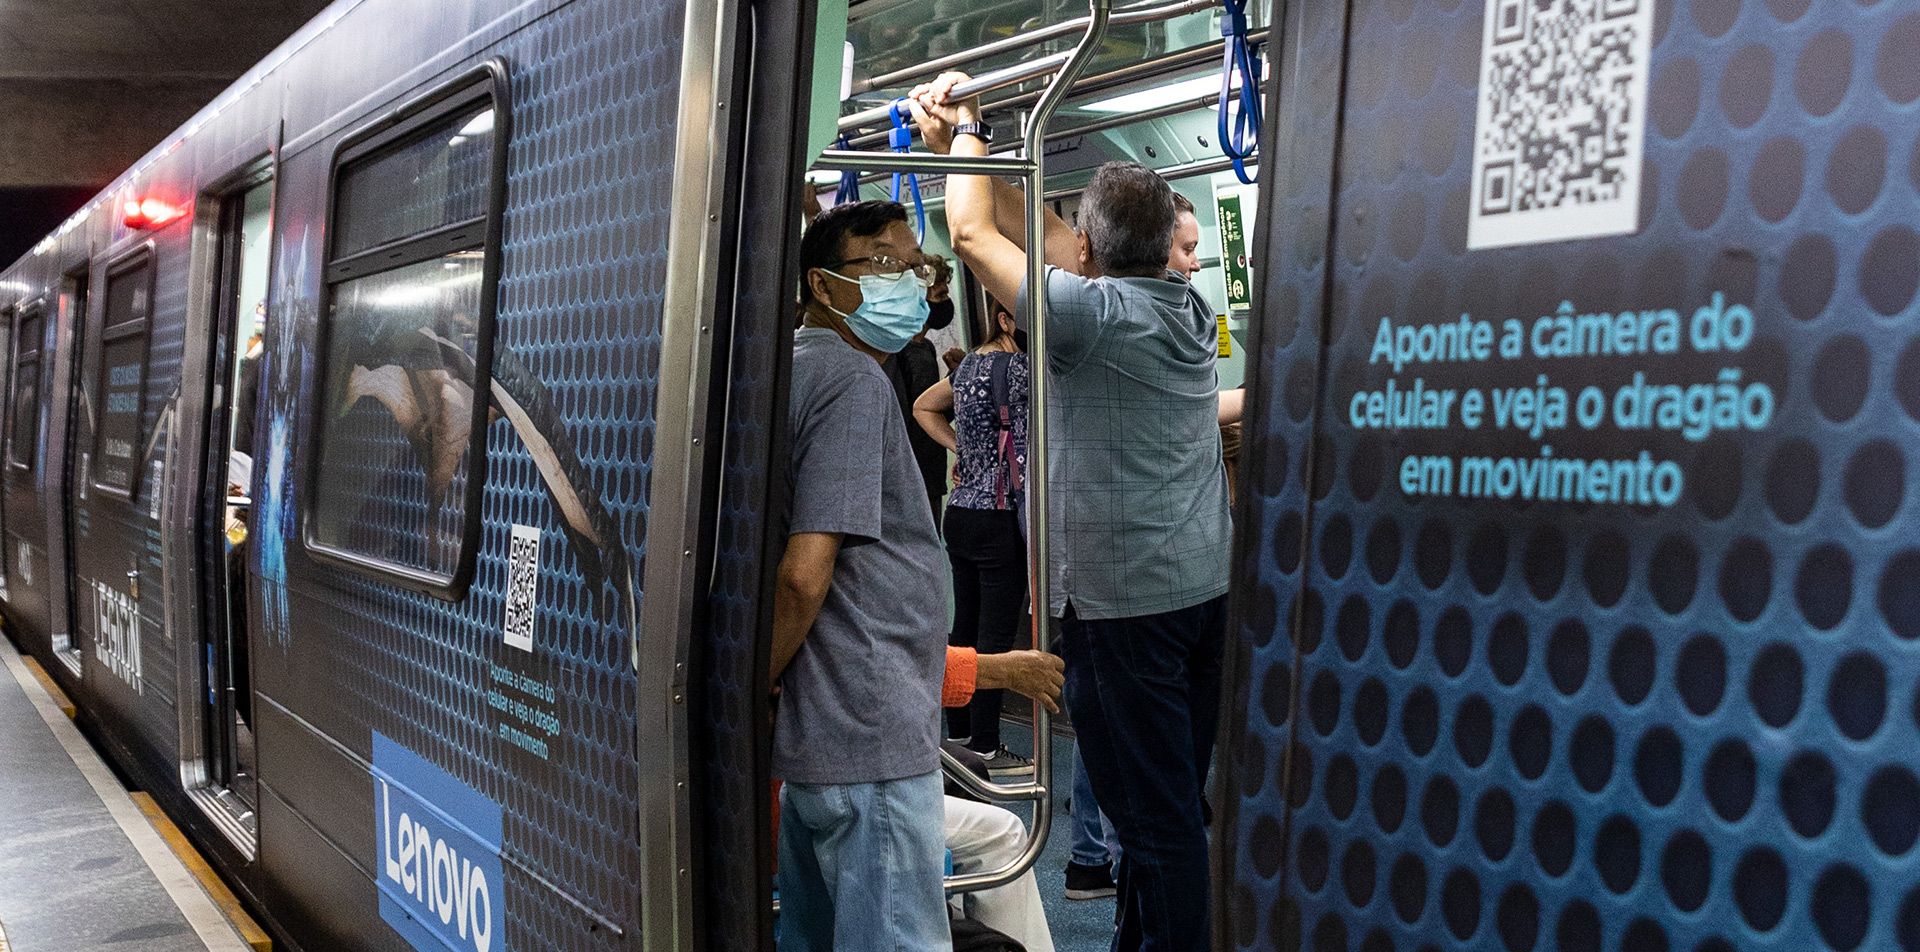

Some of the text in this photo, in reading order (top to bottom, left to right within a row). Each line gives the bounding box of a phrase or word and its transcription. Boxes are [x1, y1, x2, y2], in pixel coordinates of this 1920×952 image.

[1369, 290, 1755, 373] Aponte a câmera do
[1349, 367, 1774, 441] celular e veja o dragão
[1400, 444, 1684, 505] em movimento
[488, 687, 508, 713] celular
[514, 698, 528, 725] veja
[535, 705, 560, 736] dragão
[490, 660, 513, 687] Aponte
[520, 670, 544, 699] câmera
[545, 681, 555, 704] do
[500, 722, 549, 760] em movimento
[382, 779, 492, 952] Lenovo
